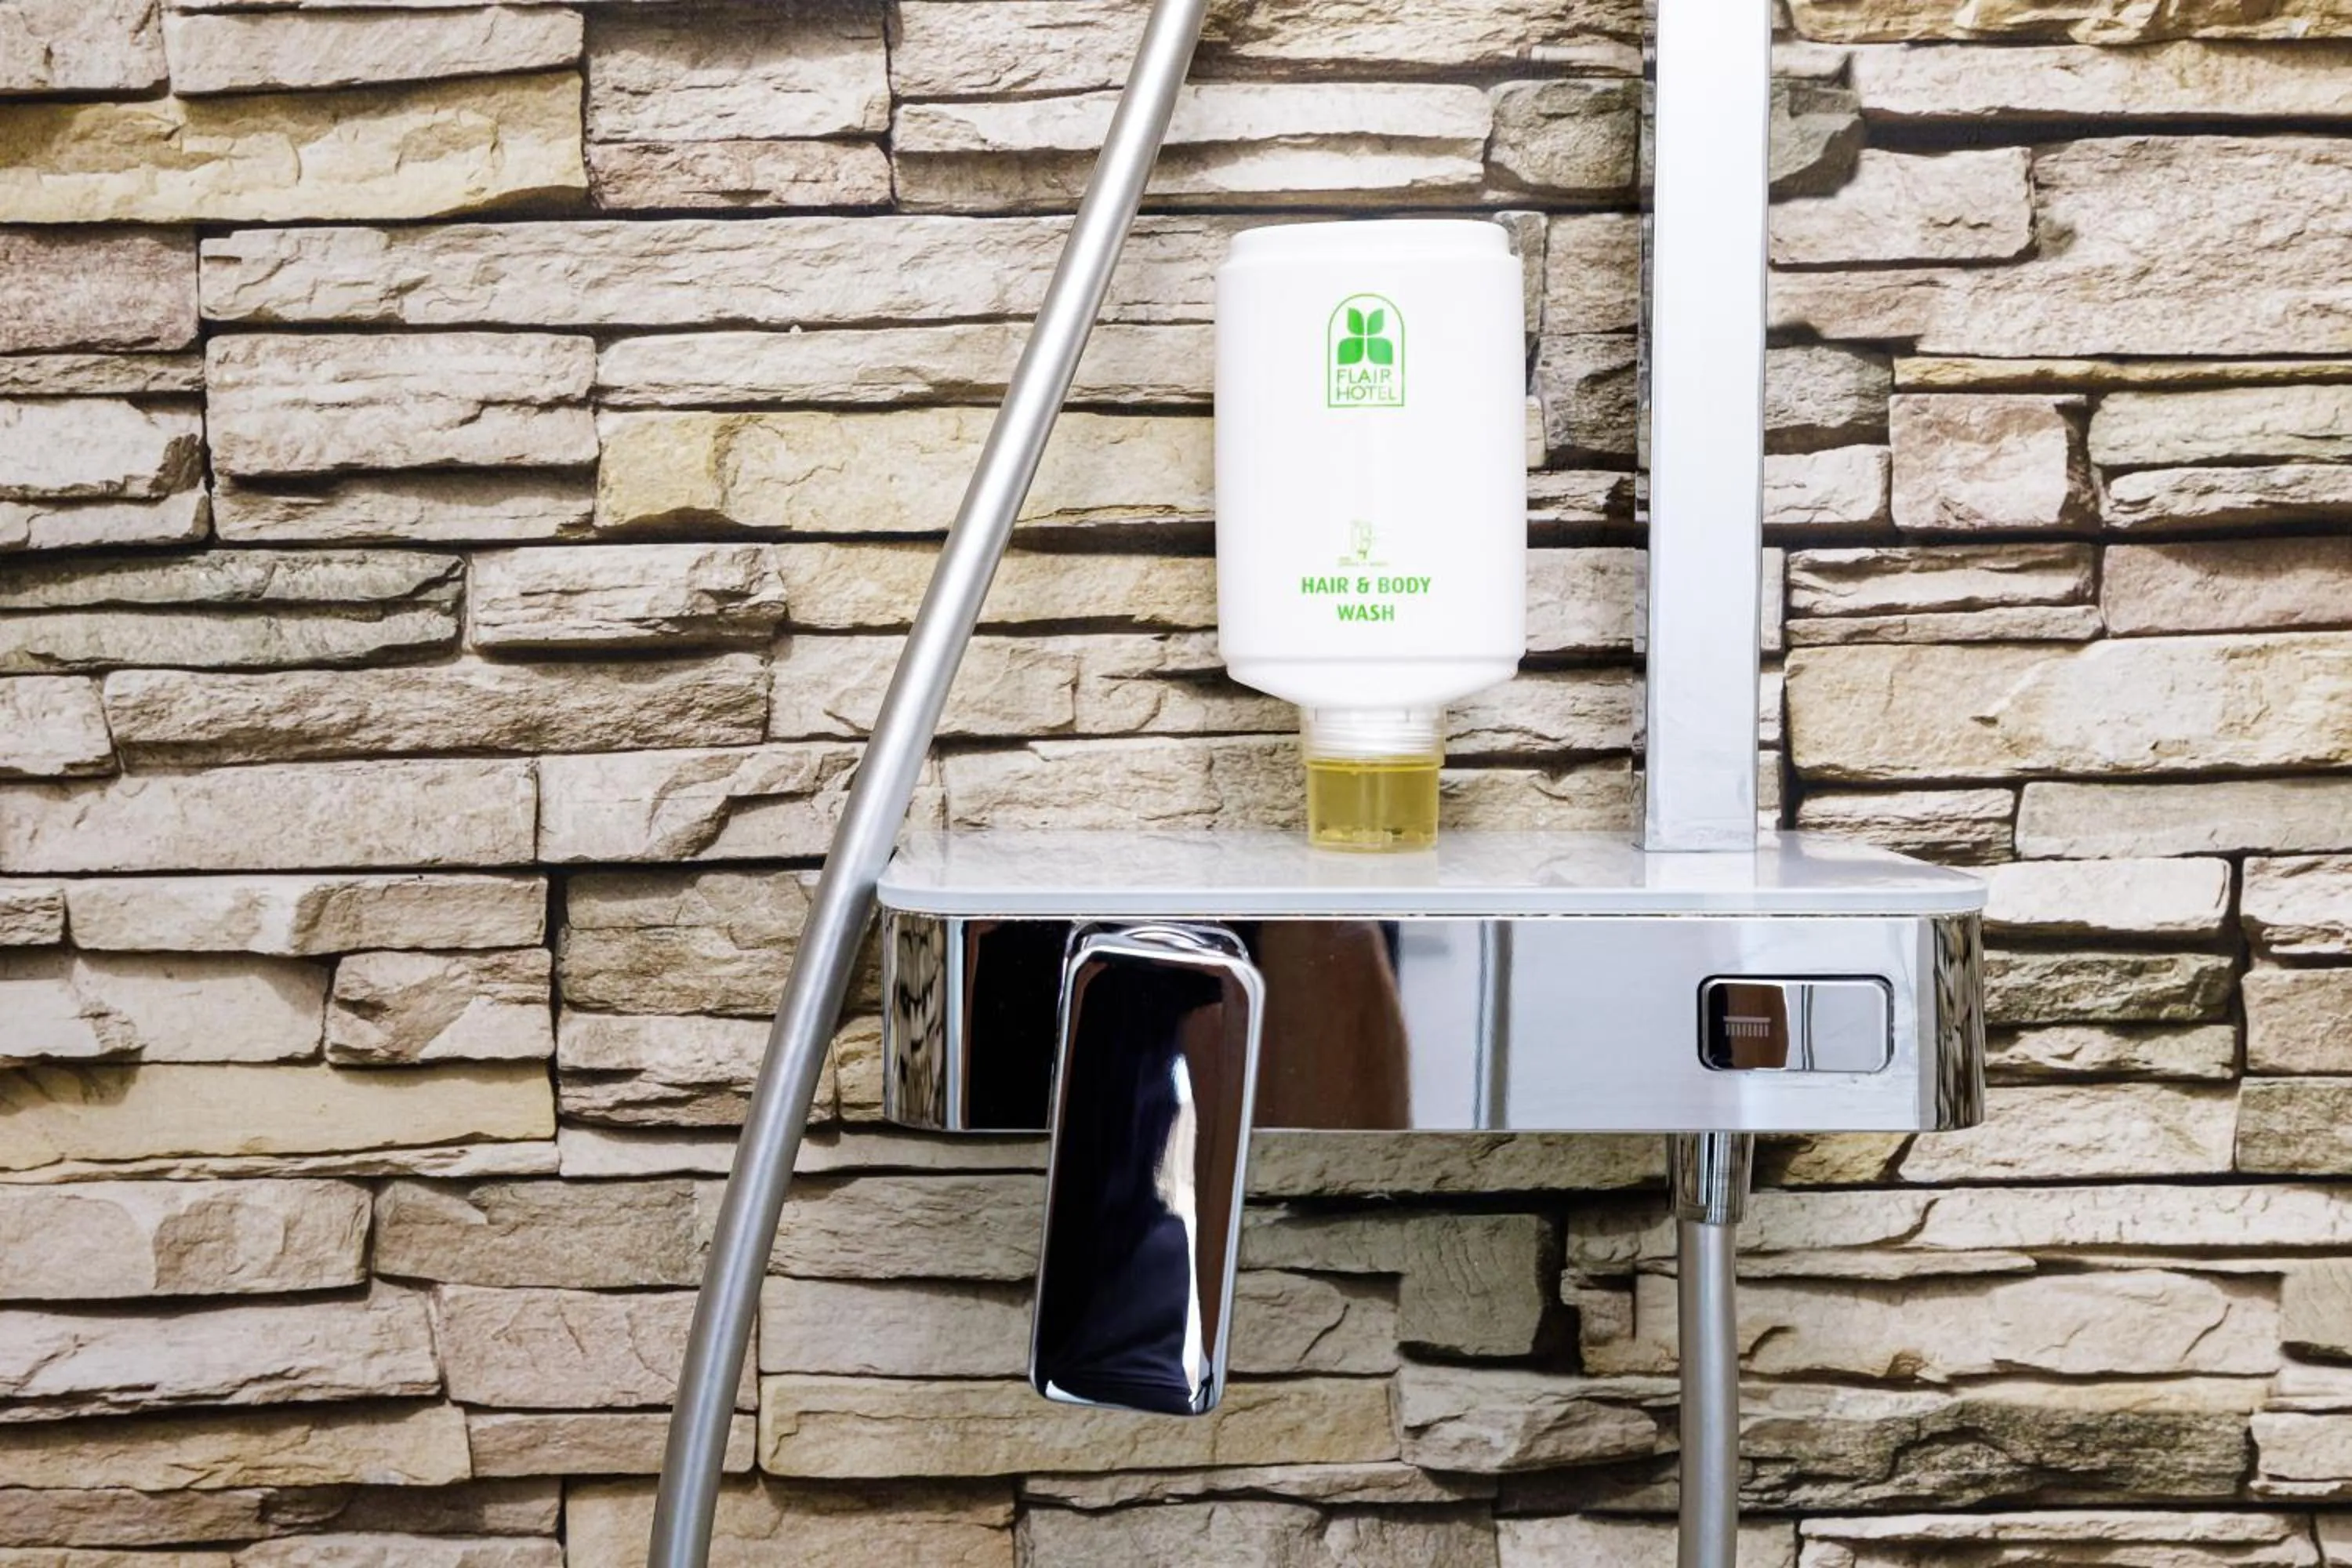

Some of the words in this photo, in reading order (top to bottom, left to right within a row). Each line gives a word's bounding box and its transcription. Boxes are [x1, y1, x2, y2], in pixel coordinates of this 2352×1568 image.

[1337, 368, 1392, 383] FLAIR
[1337, 386, 1396, 401] HOTEL
[1301, 576, 1348, 593] HAIR
[1356, 576, 1370, 593] &
[1377, 576, 1432, 593] BODY
[1337, 604, 1396, 621] WASH
